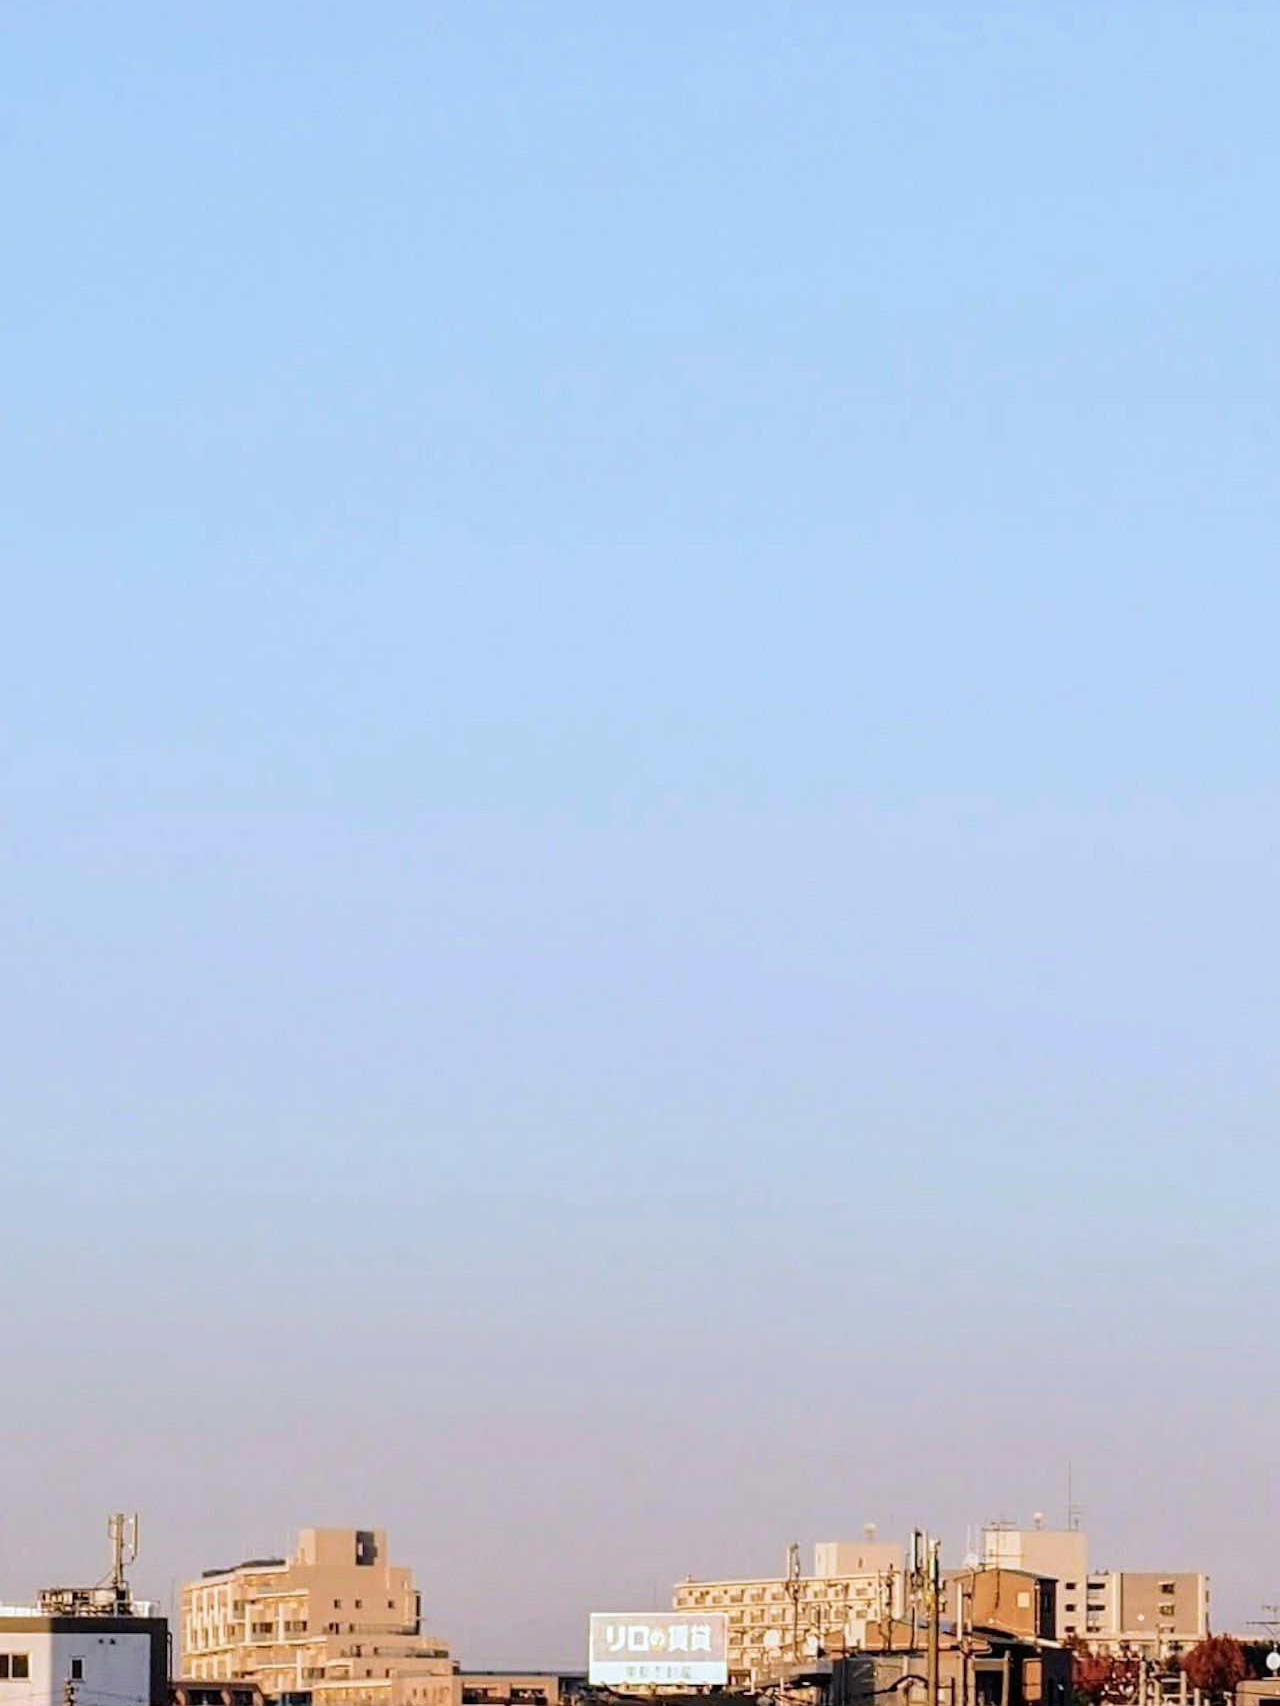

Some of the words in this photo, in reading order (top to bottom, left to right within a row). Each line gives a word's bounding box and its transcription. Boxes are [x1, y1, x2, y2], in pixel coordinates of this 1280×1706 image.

[606, 1624, 712, 1653] リロの賃貸
